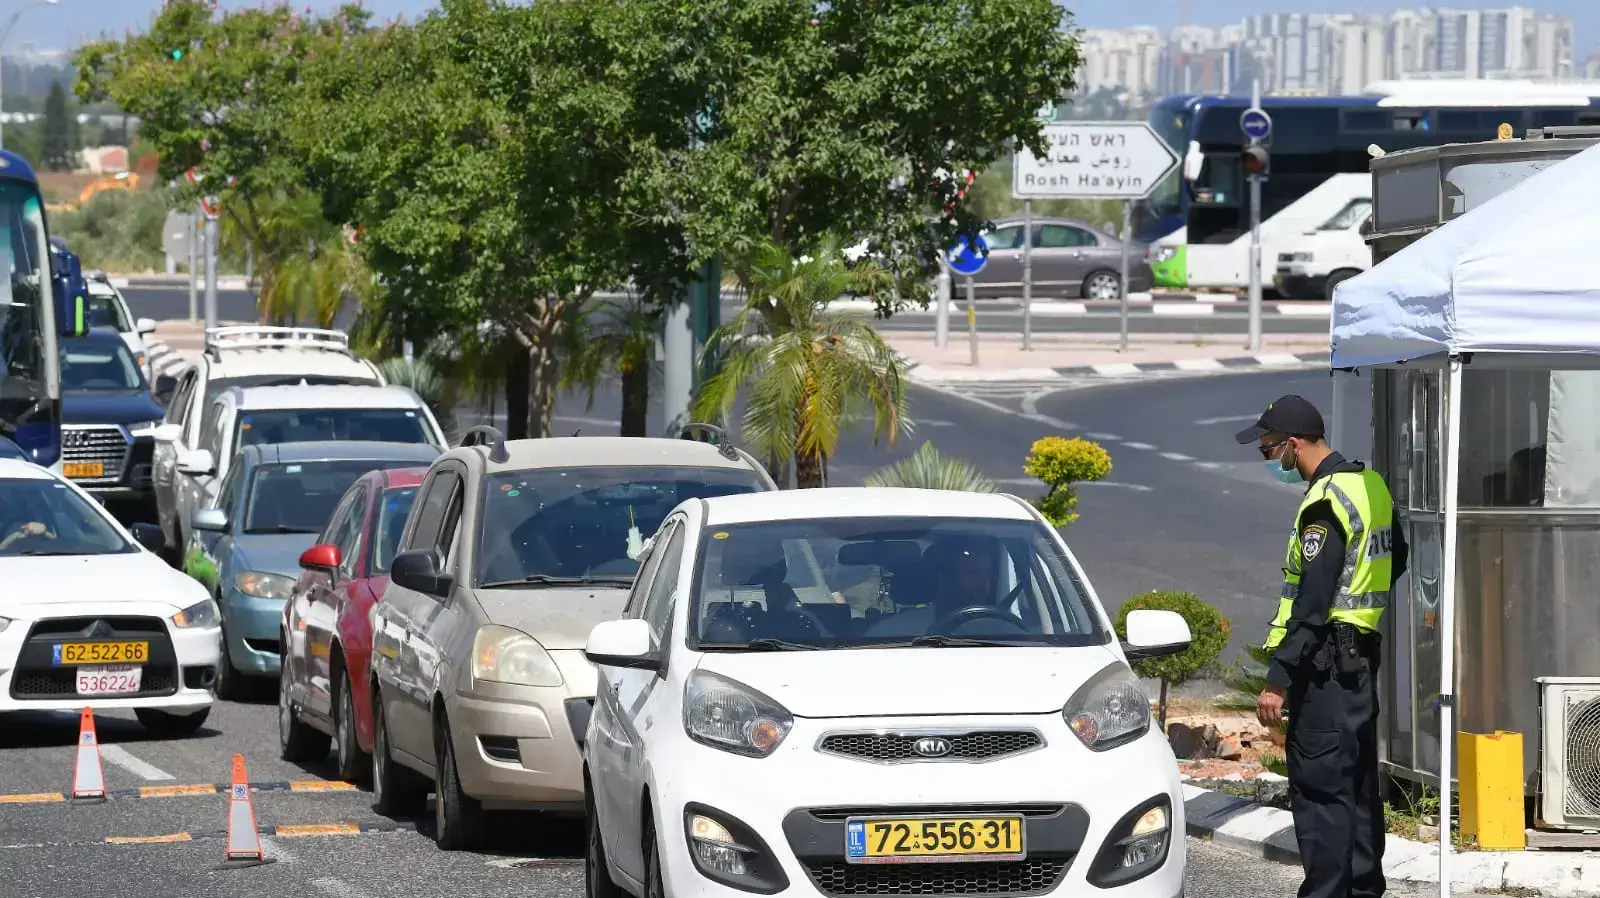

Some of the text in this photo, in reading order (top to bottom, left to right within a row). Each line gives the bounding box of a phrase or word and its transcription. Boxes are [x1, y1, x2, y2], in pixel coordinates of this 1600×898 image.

[1045, 133, 1126, 147] ראש העי
[1090, 152, 1131, 168] روش
[1025, 173, 1142, 189] Rosh Ha'ayin
[66, 645, 86, 660] 62
[91, 644, 120, 660] 522
[124, 643, 143, 659] 66
[80, 675, 136, 691] 536224
[919, 741, 947, 752] KIA
[851, 832, 861, 846] IL
